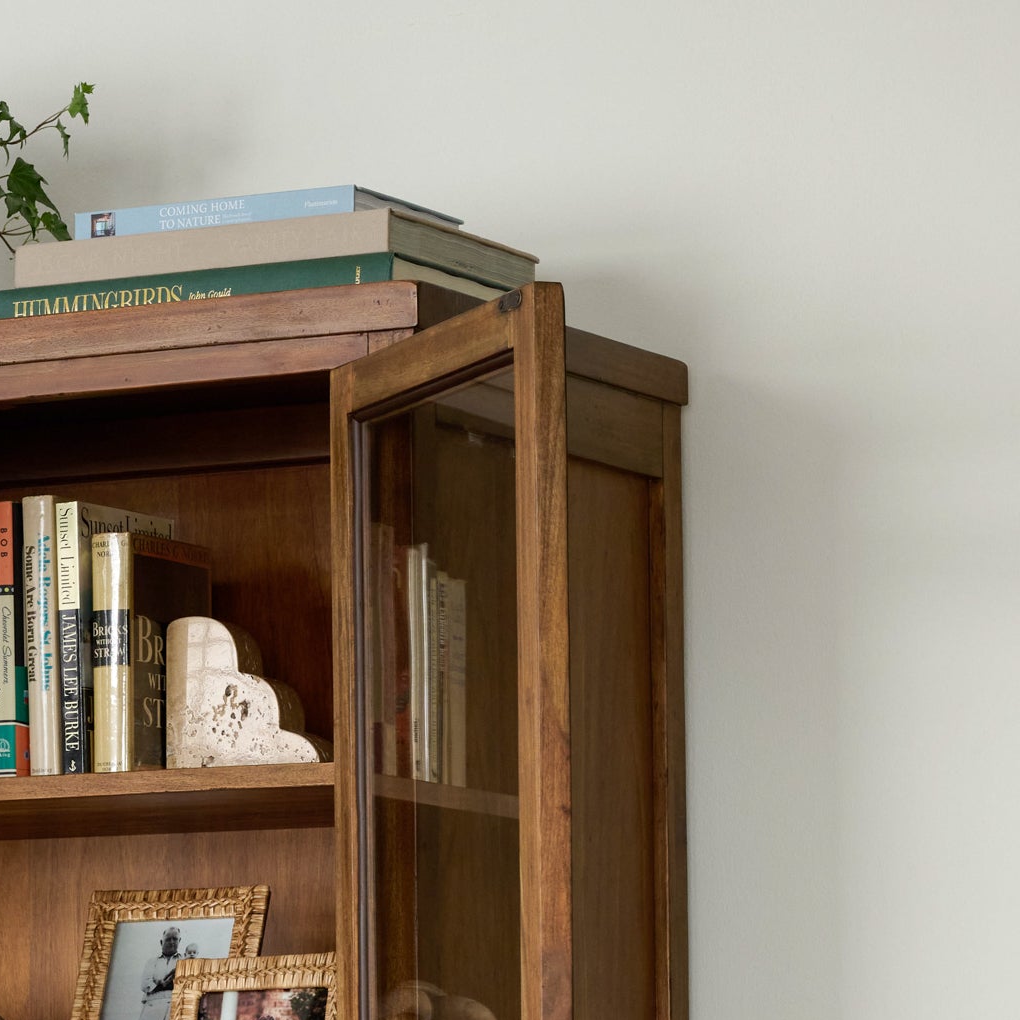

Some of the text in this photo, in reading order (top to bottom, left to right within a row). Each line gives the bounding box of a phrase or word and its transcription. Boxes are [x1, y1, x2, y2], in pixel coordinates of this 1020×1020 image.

[159, 199, 245, 217] COMING HOME
[160, 219, 174, 230] TO
[177, 214, 221, 229] NATURE
[81, 507, 124, 539] Sunset
[0, 527, 8, 558] BOB
[59, 507, 76, 605] Sunset Limited
[1, 606, 12, 643] Chevrolet
[25, 545, 37, 683] Some Are Born Great
[61, 614, 80, 752] JAMES LEE BURKE
